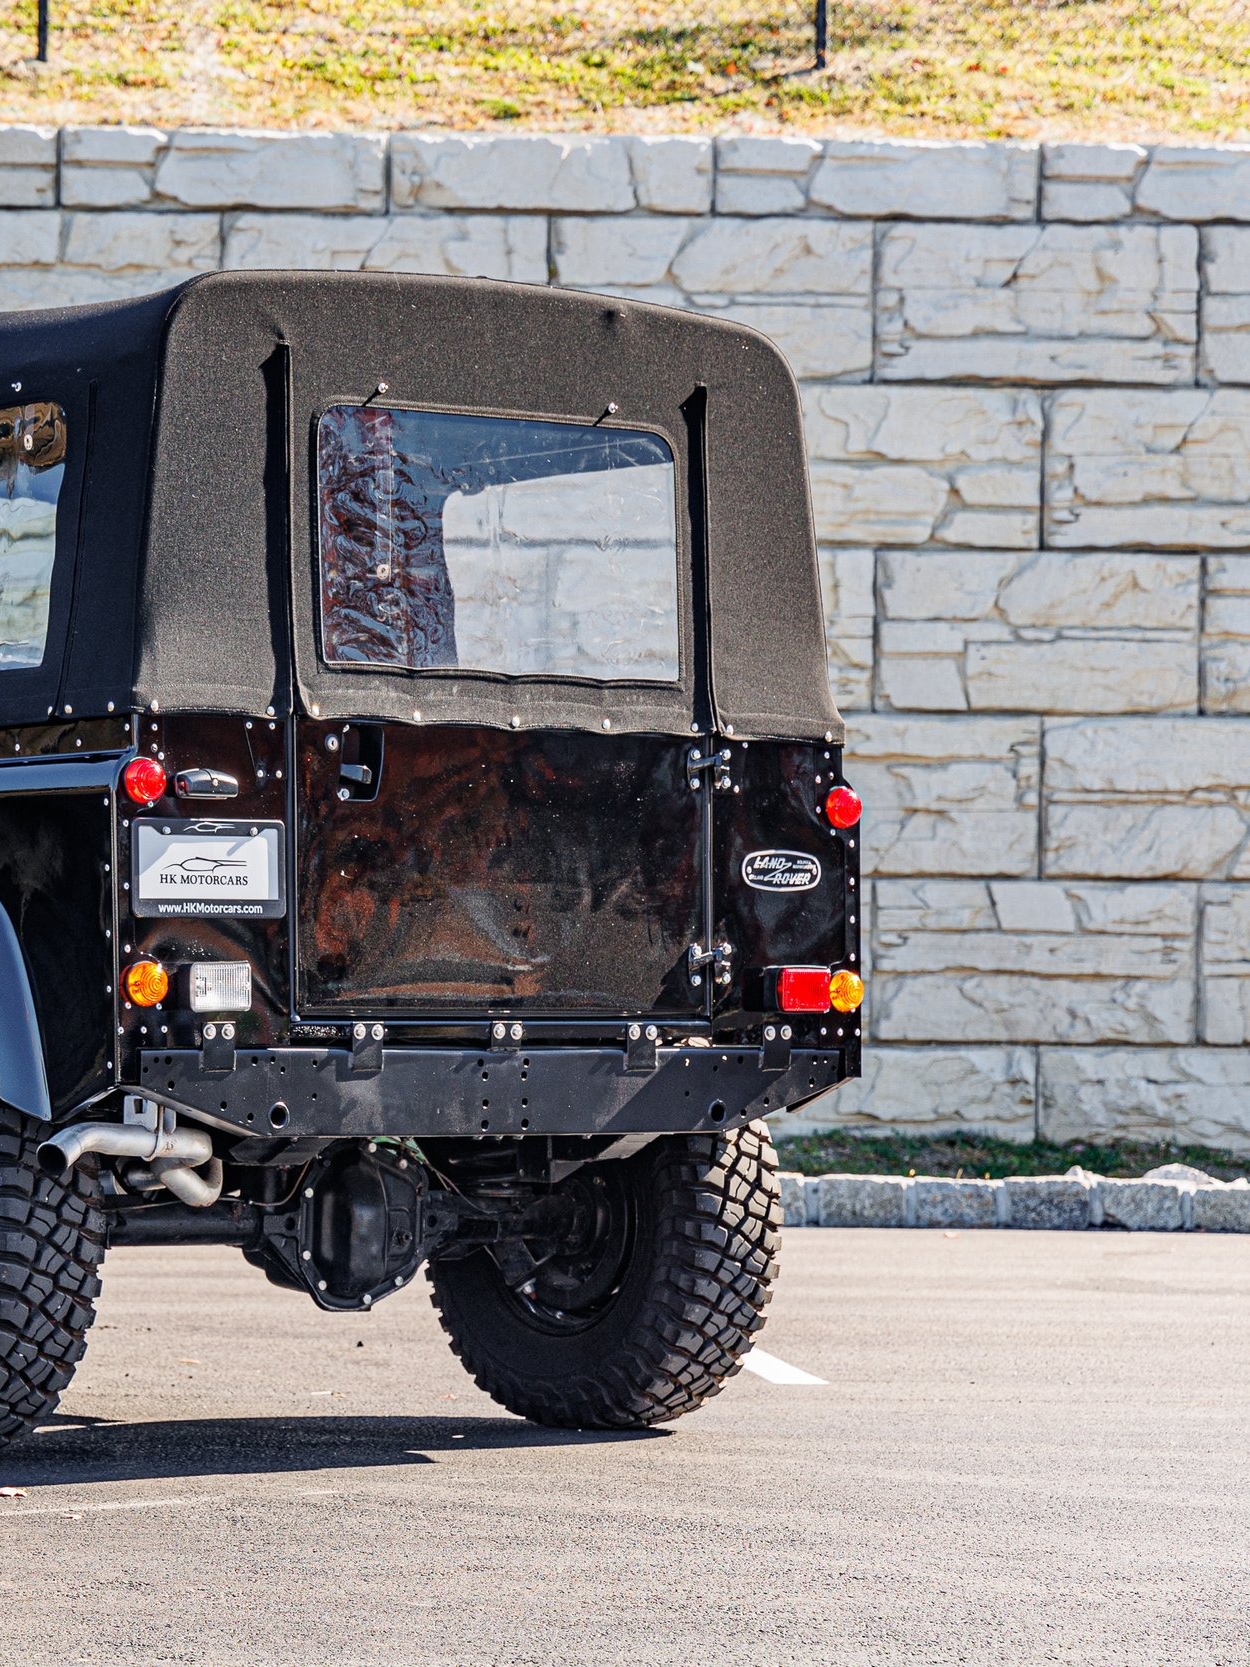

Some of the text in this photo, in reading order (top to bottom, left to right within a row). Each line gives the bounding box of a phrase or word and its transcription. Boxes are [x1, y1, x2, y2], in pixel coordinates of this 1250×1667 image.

[753, 855, 786, 869] LAND
[160, 874, 248, 886] HK MOTORCARS
[772, 872, 811, 885] ROVER
[158, 902, 263, 914] www.HKMotorcars.com
